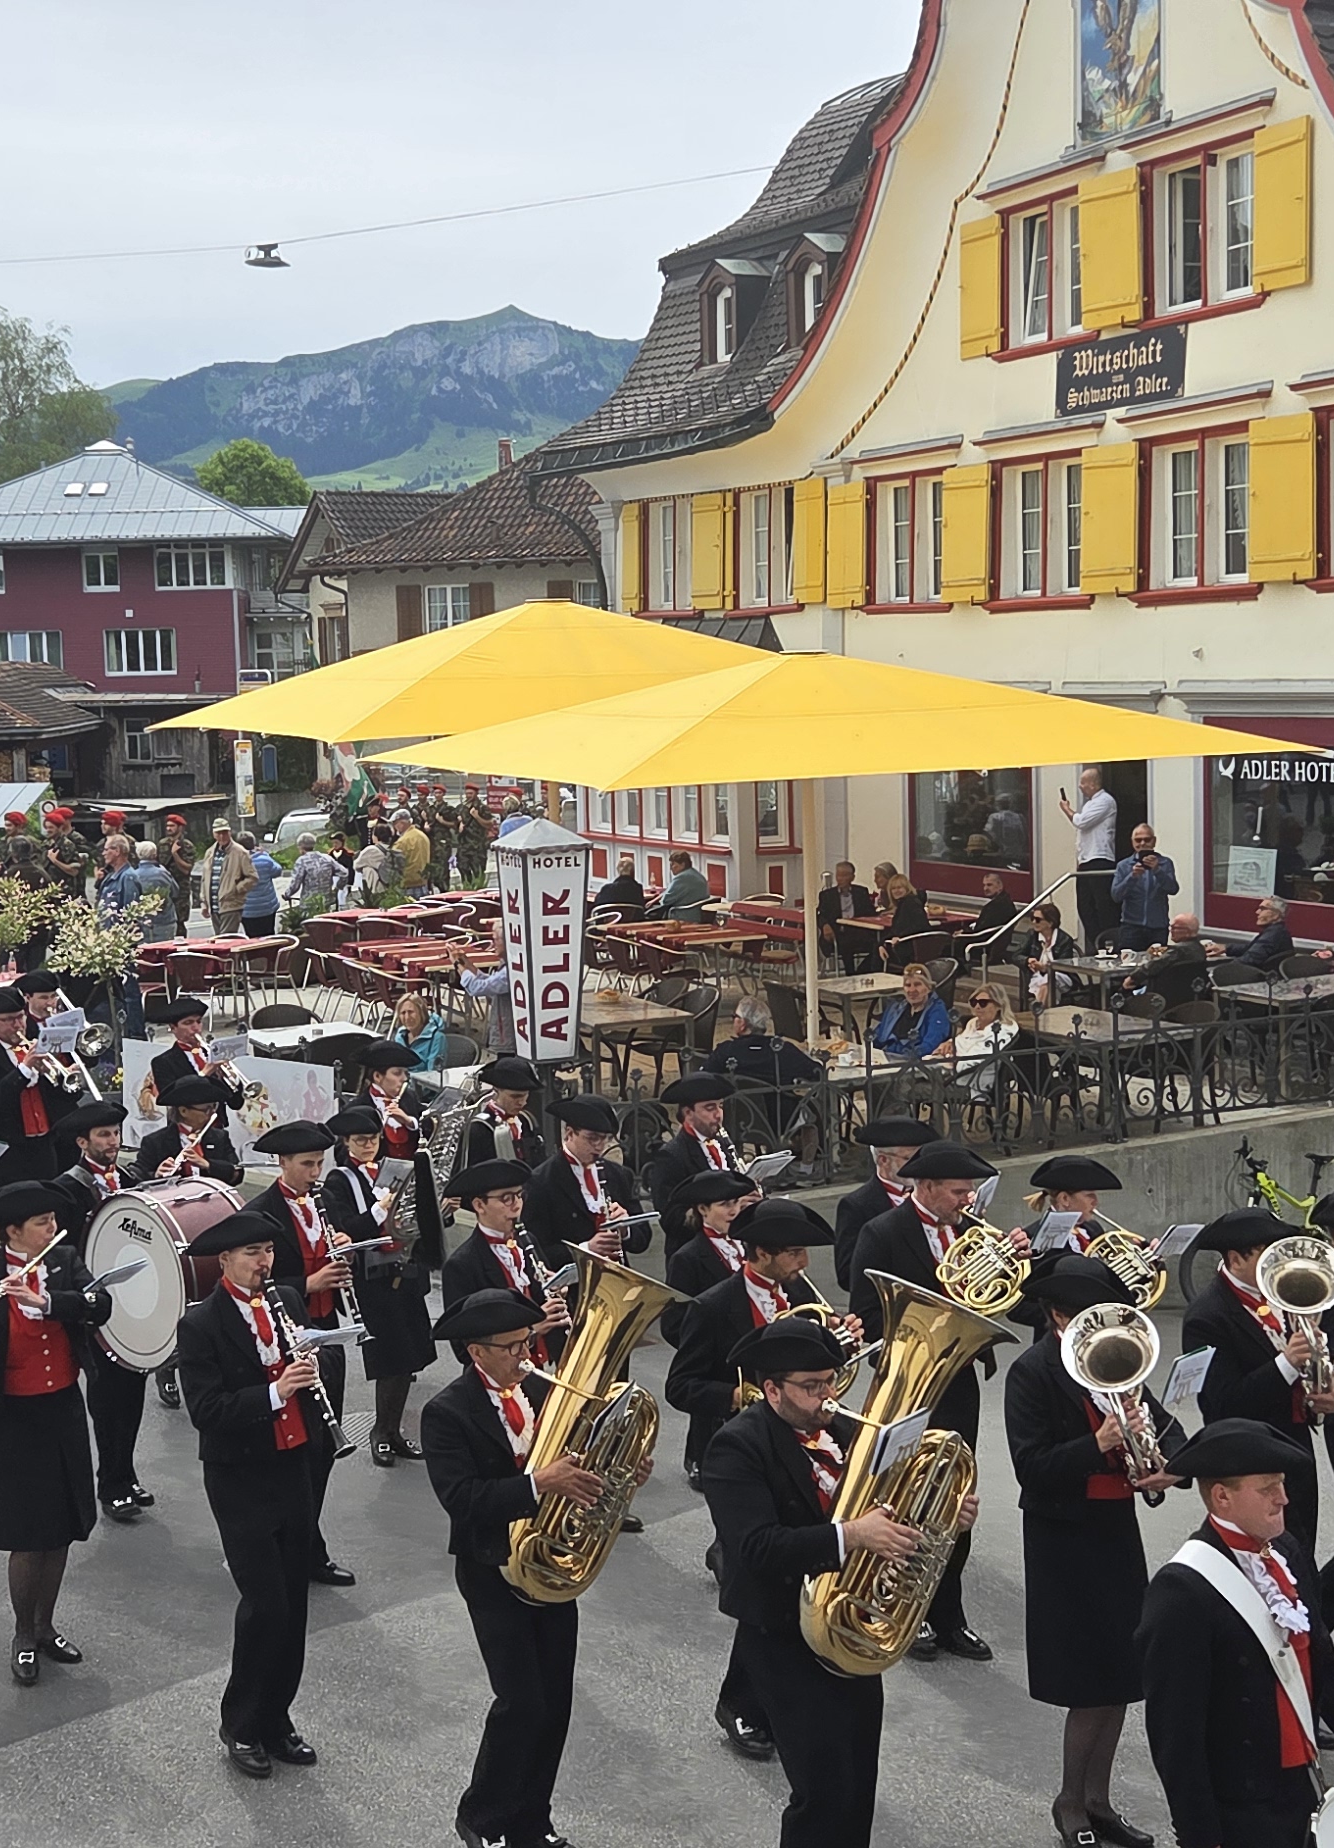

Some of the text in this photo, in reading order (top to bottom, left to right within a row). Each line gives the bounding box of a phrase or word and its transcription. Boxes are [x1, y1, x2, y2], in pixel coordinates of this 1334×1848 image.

[1072, 337, 1163, 378] Wirtschaft
[1067, 383, 1130, 410] Schwarzen
[1240, 759, 1291, 782] ADLER
[532, 856, 581, 869] HOTEL
[507, 888, 530, 1043] ADLER
[540, 889, 571, 1042] ADLER
